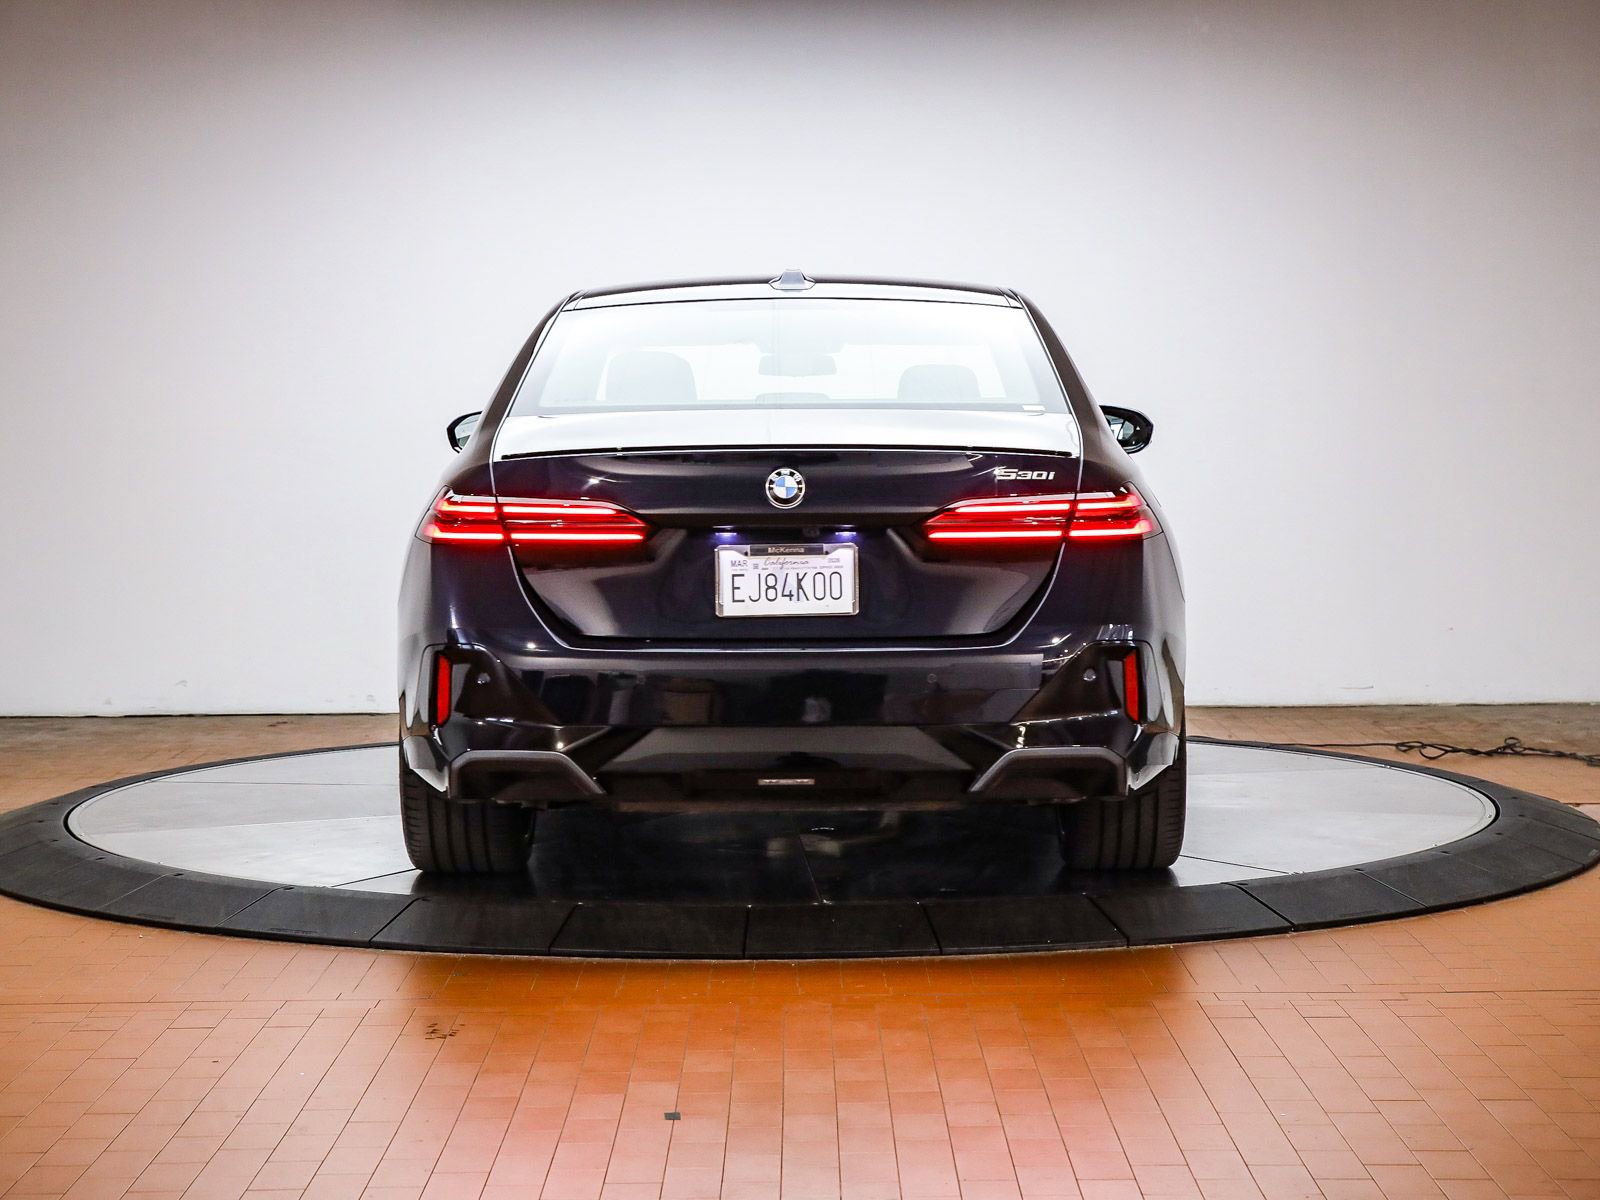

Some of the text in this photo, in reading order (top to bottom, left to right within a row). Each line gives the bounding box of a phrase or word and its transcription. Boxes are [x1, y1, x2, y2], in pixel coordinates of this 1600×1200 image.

[730, 559, 748, 568] MAR
[763, 556, 810, 570] California
[731, 571, 843, 603] EJ84K00
